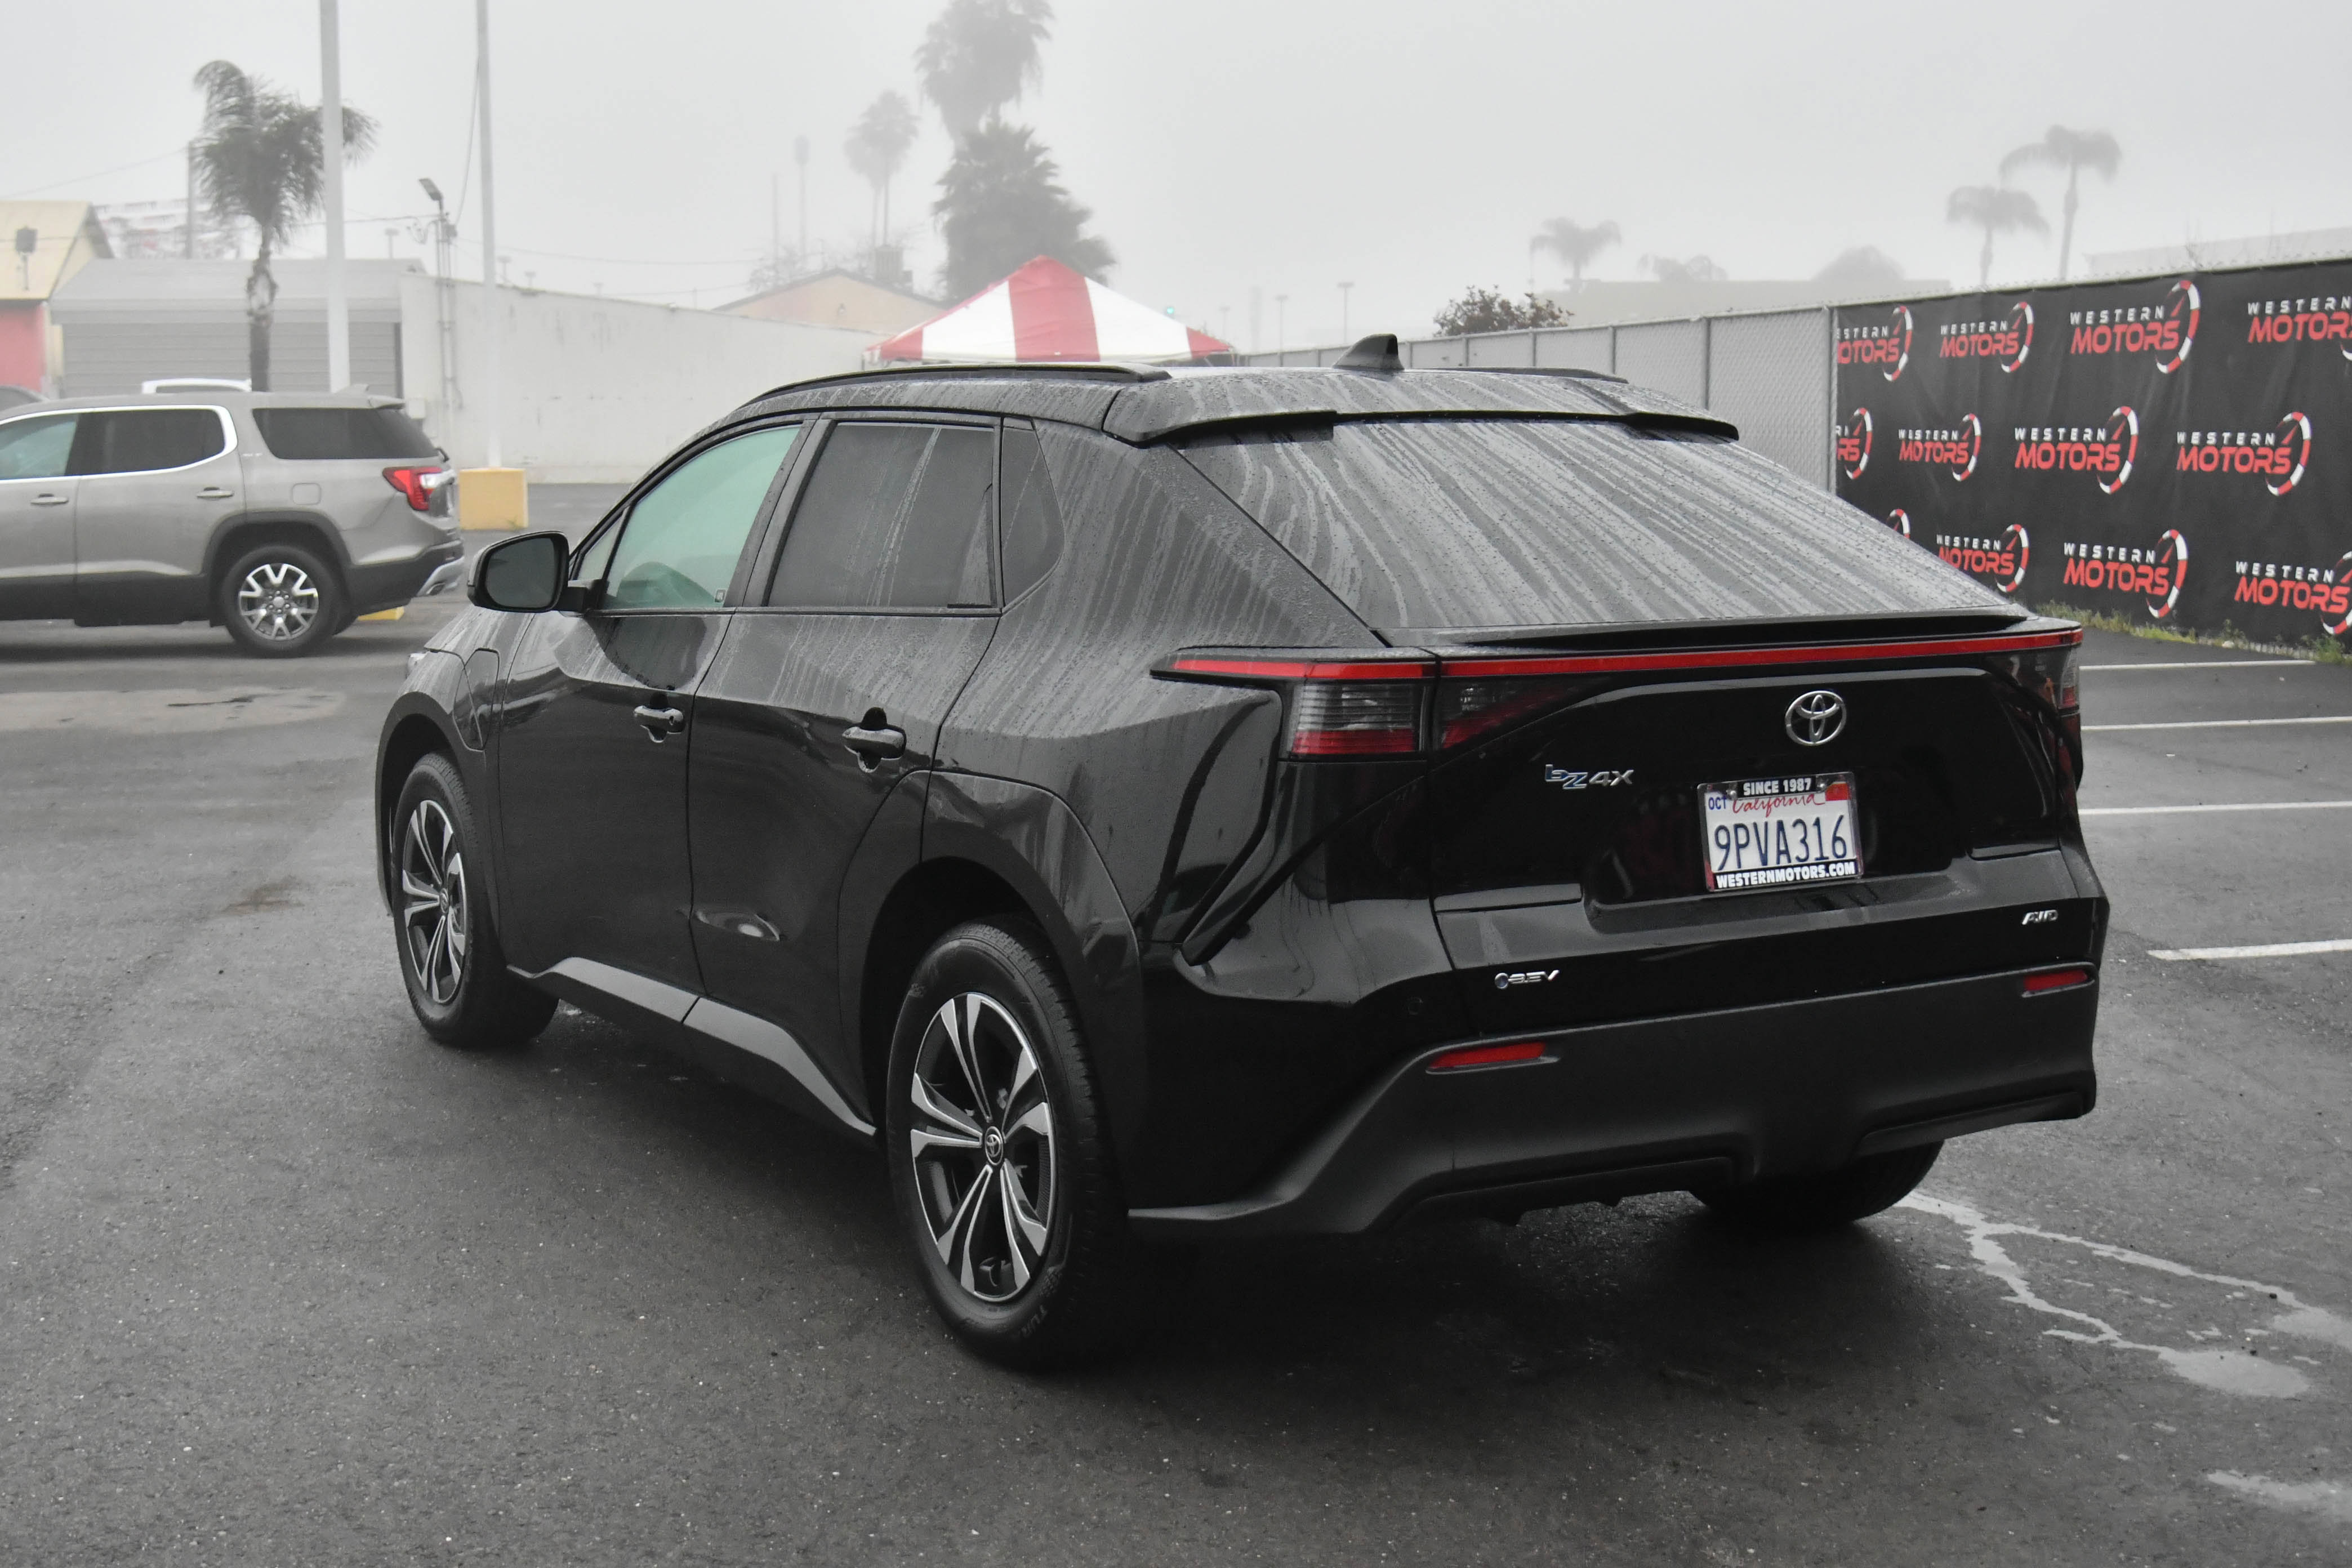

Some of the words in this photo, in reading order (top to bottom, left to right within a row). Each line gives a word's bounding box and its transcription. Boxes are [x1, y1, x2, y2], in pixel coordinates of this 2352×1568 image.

[2070, 305, 2164, 325] WESTERN
[2248, 296, 2351, 315] WESTERN
[1940, 320, 2008, 336] WESTERN
[2070, 319, 2180, 354] MOTORS
[2248, 310, 2352, 343] MOTOR
[1940, 331, 2019, 359] MOTORS
[2015, 427, 2106, 442] WESTERN
[2177, 431, 2275, 446] WESTERN
[1899, 440, 1969, 465] MOTORS
[2015, 442, 2121, 473] MOTORS
[2177, 445, 2292, 475] MOTORS
[1936, 534, 2001, 550] WESTERN
[2064, 542, 2155, 564] WESTERN
[2063, 557, 2170, 597] MOTORS
[2235, 561, 2334, 583] WESTERN
[2234, 576, 2351, 614] MOTORS
[1743, 780, 1779, 796] SINCE
[1783, 778, 1812, 792] 1987
[1708, 796, 1728, 810] OCT
[1714, 814, 1847, 871] 9PVA316
[1716, 862, 1855, 889] WESTERNMOTORS.COM
